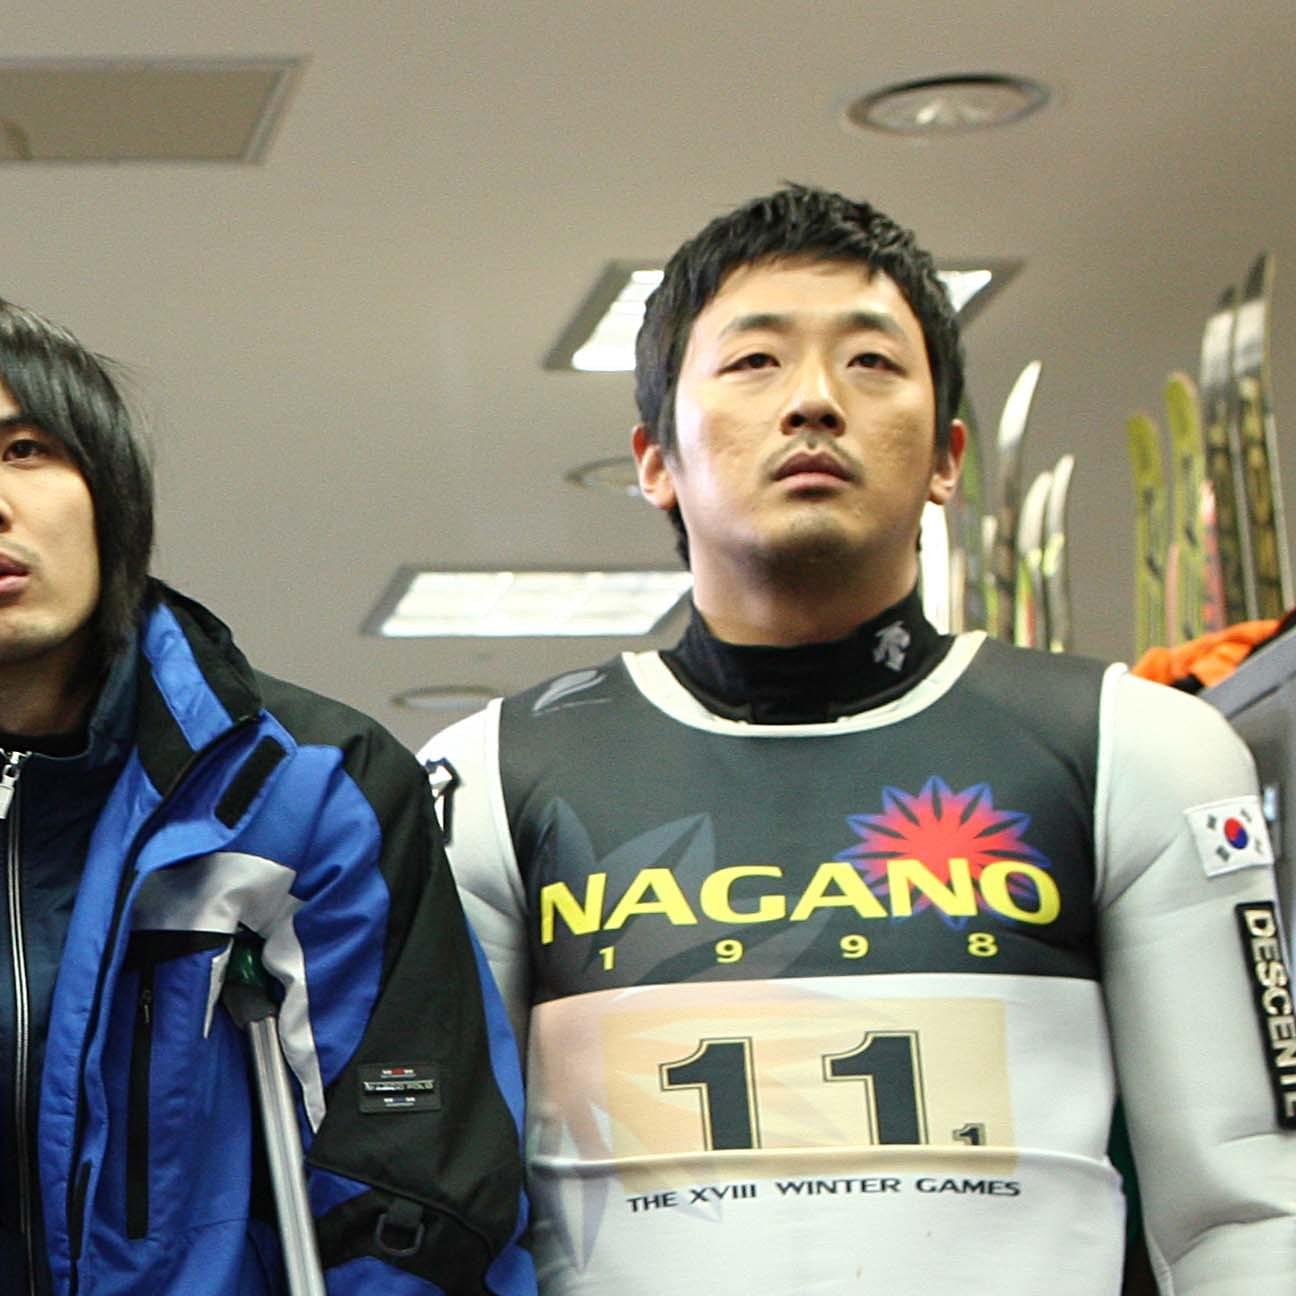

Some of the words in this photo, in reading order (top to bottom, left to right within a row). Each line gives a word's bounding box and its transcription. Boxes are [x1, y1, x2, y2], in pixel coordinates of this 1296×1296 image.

[540, 856, 1061, 944] NAGANO
[658, 1030, 927, 1150] 11
[628, 1190, 677, 1214] THE
[690, 1182, 757, 1207] XVIII
[775, 1176, 902, 1197] WINTER
[915, 1175, 1021, 1199] GAMES
